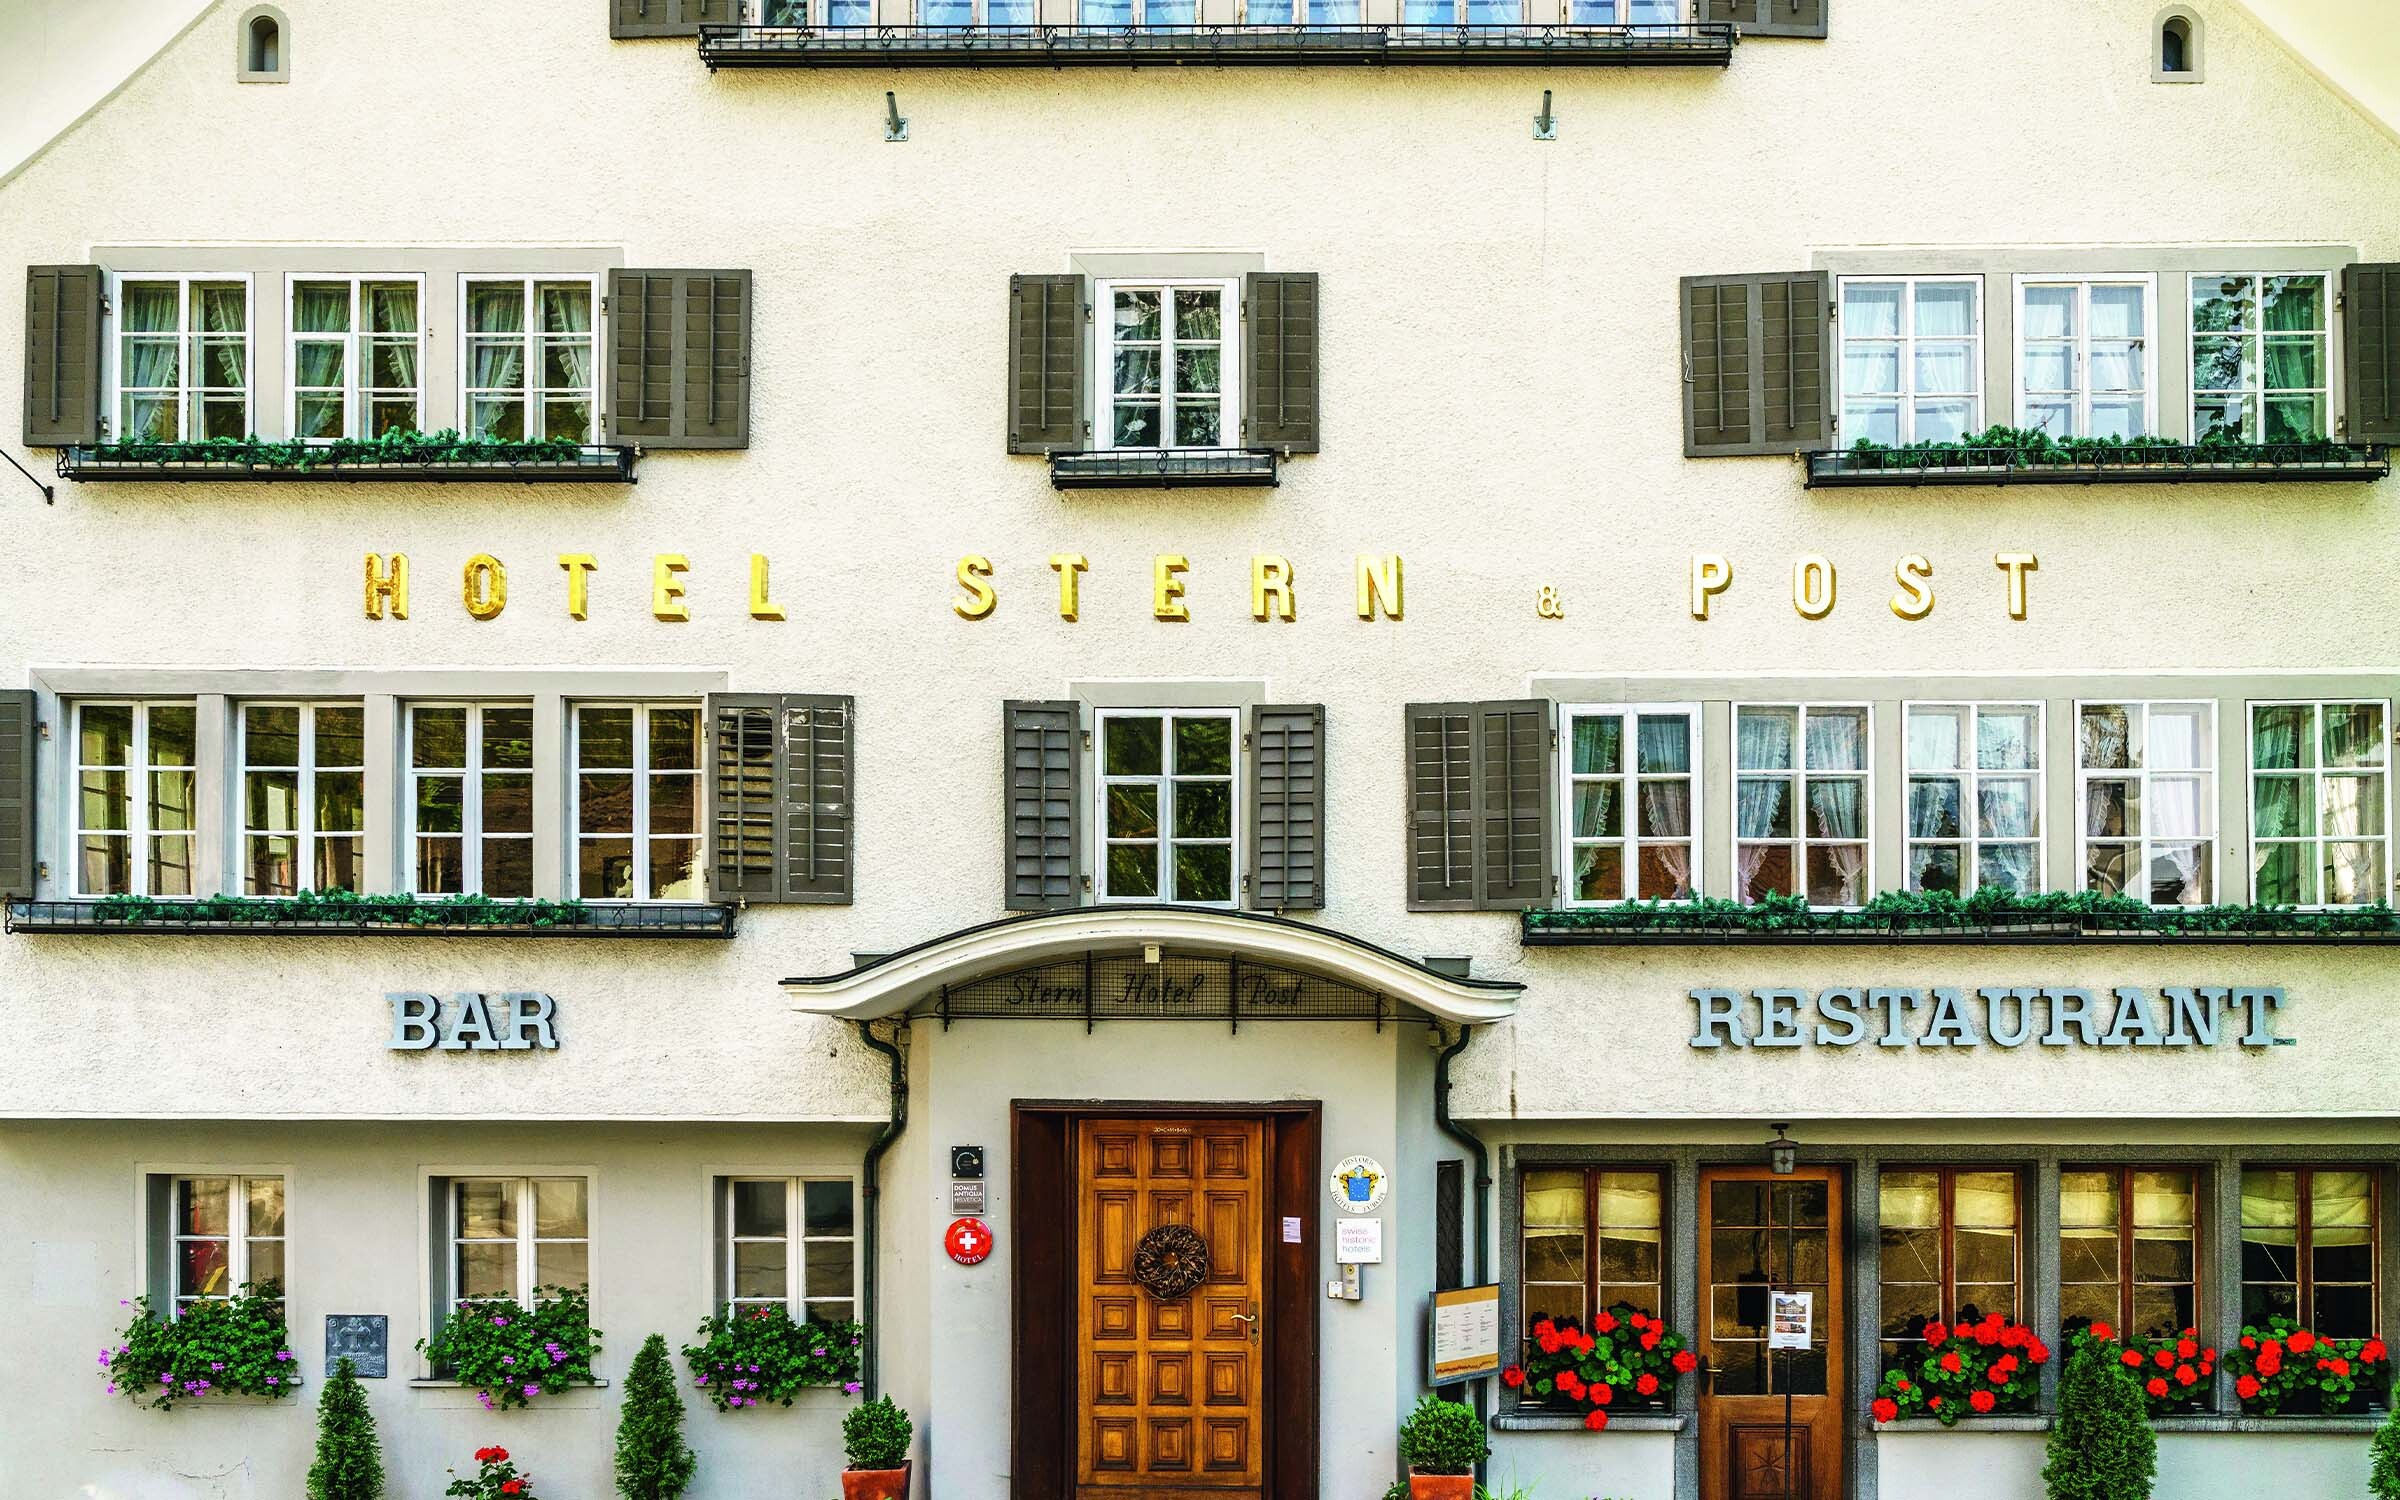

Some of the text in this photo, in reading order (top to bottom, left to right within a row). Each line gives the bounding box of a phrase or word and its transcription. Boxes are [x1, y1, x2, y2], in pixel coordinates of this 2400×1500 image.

[364, 550, 2038, 621] HOTEL STERN & POST
[1005, 972, 1304, 1005] Stern Hotel Post
[384, 991, 560, 1051] BAR
[1689, 986, 2286, 1048] RESTAURANT
[1341, 1228, 1369, 1236] swiss
[1341, 1236, 1377, 1244] historic
[953, 1253, 984, 1264] HOTEL
[1341, 1245, 1372, 1254] hotels
